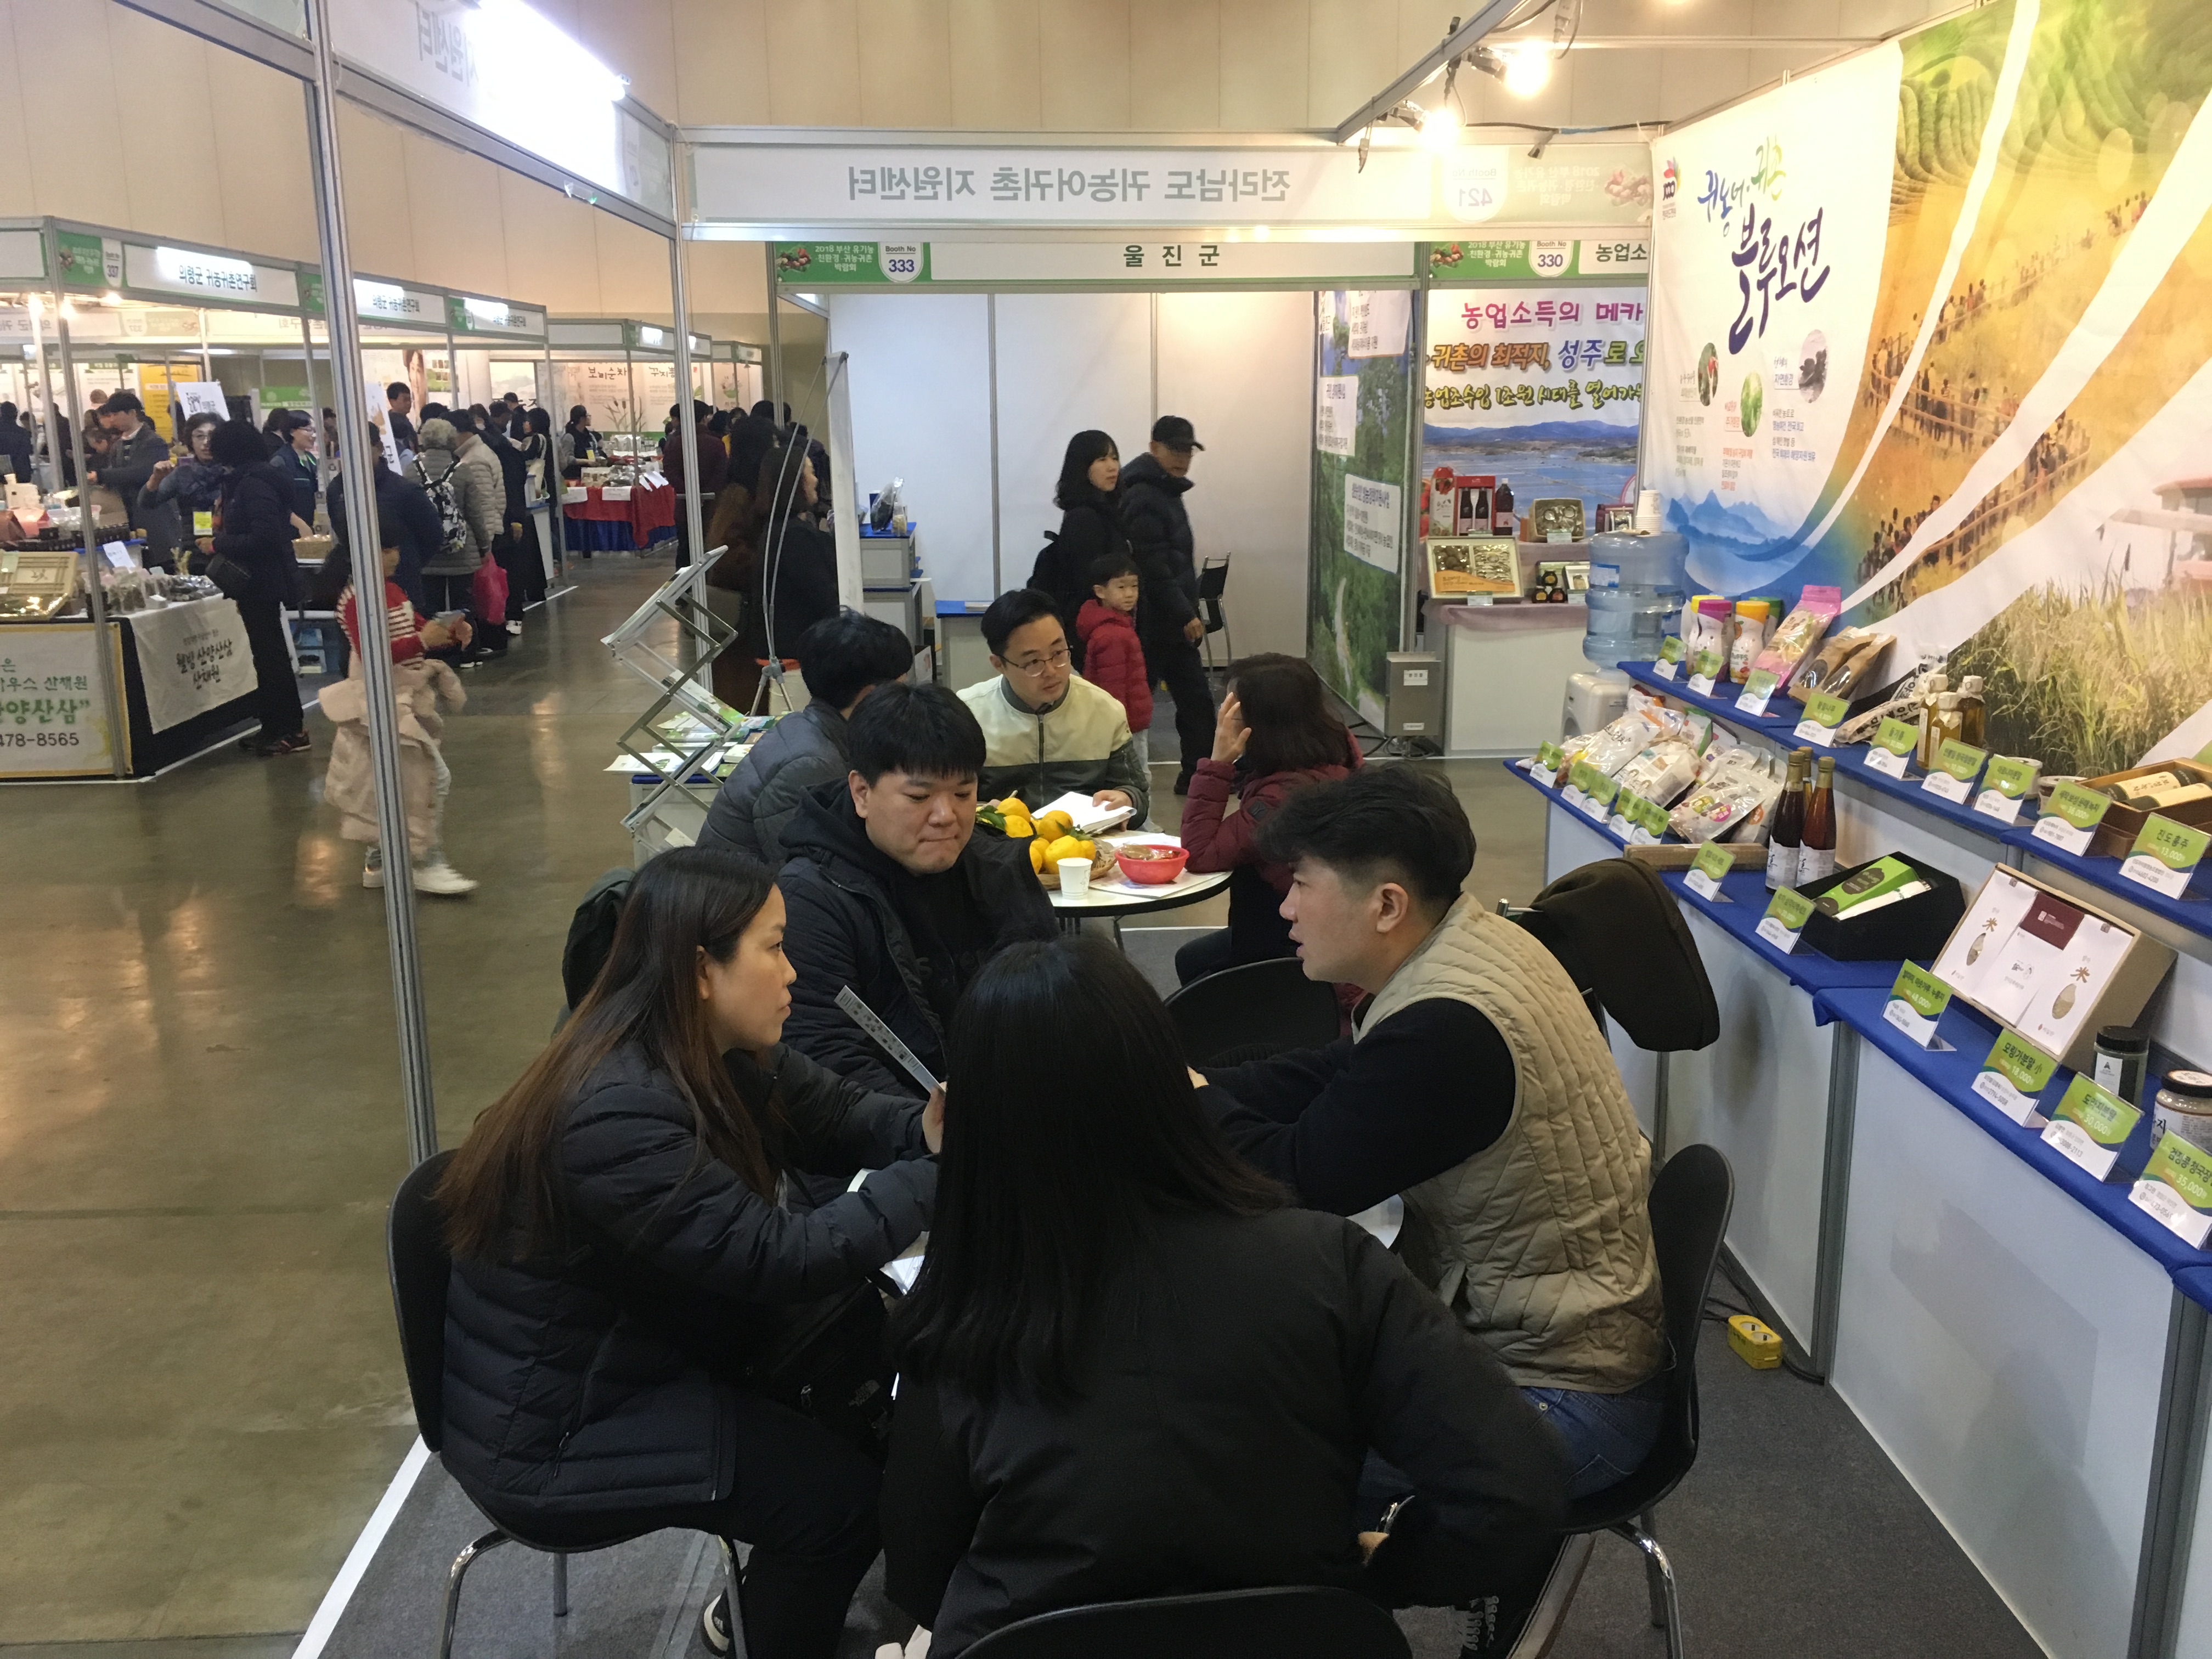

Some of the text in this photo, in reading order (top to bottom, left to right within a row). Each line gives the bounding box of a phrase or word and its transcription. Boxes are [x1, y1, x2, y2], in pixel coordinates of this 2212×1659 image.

[836, 245, 850, 253] 부산
[853, 245, 874, 253] 유기농
[889, 259, 915, 272] 333
[1537, 254, 1563, 267] 330
[1462, 301, 1643, 329] 농업소득의 메카
[1538, 379, 1583, 410] 시대를
[44, 675, 88, 691] 산채원
[2157, 829, 2189, 849] 진도홍주
[2002, 1042, 2036, 1072] 모링가분말
[2083, 1093, 2117, 1121] 도라지분말
